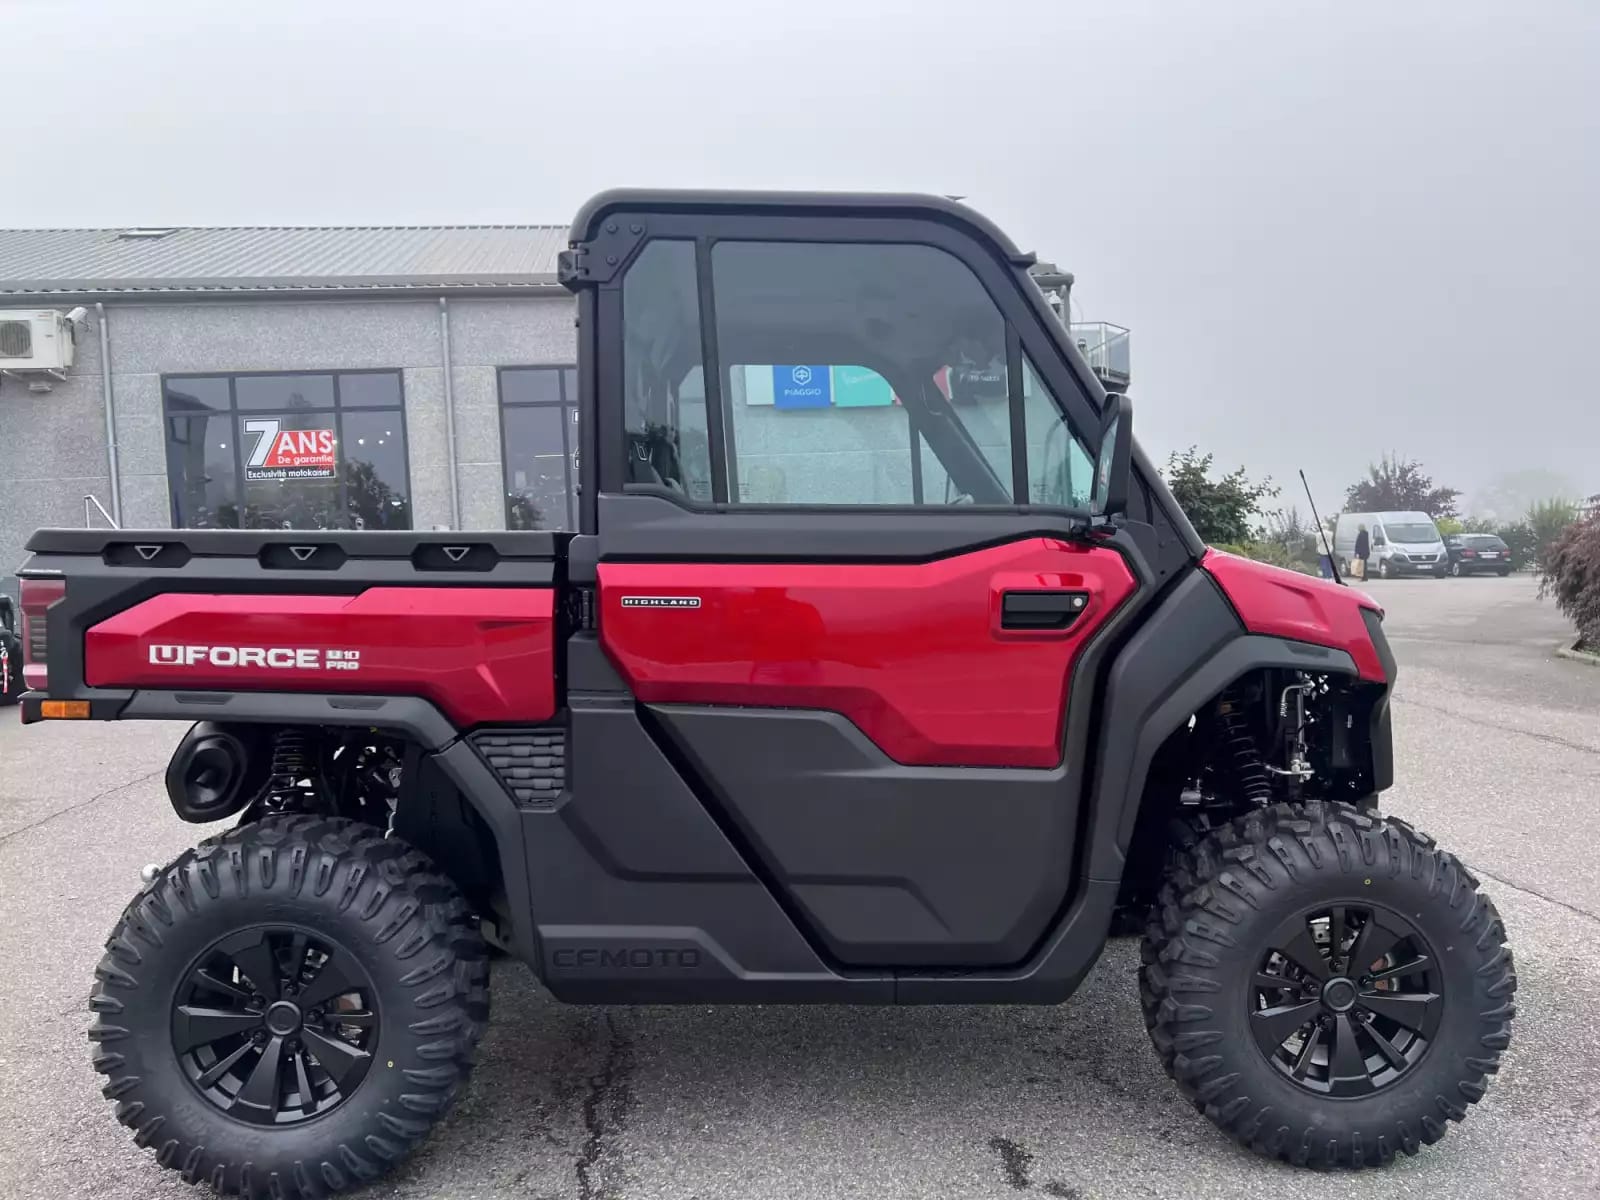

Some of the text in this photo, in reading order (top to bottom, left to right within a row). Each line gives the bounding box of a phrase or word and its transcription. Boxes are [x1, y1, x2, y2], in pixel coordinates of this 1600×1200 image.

[244, 419, 332, 466] 7 ANS
[278, 455, 332, 465] De garantie
[326, 661, 360, 670] PRO
[552, 949, 701, 968] CFMOTO
